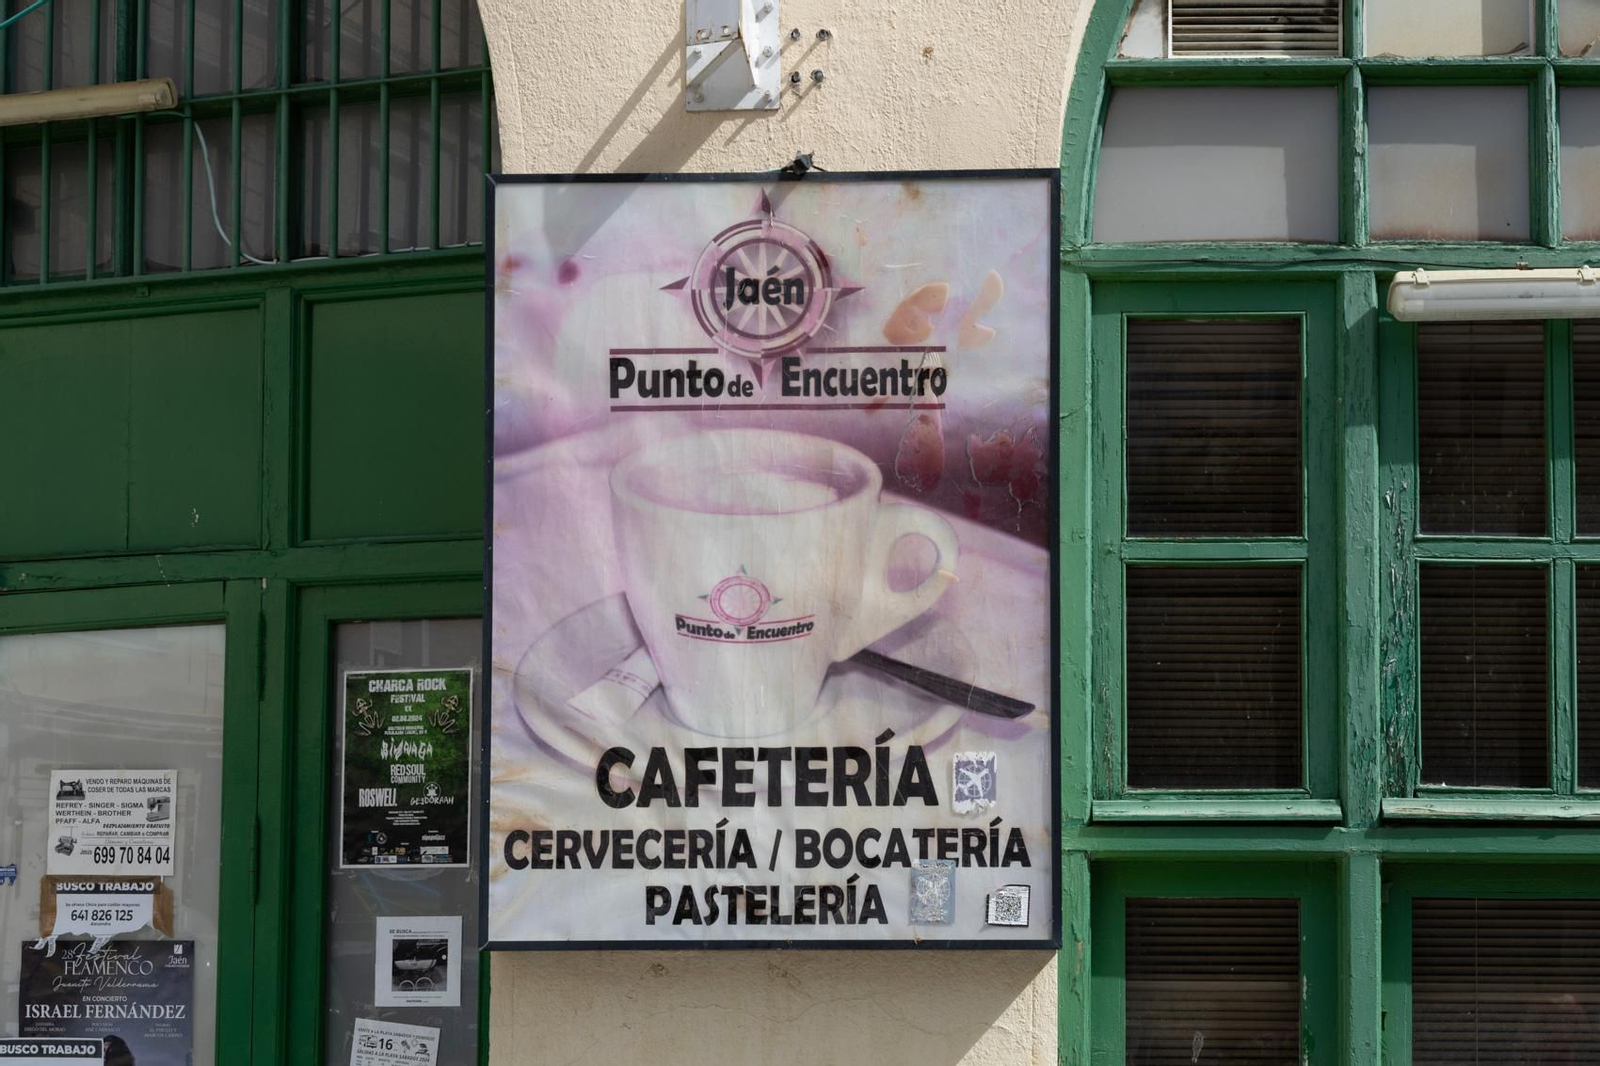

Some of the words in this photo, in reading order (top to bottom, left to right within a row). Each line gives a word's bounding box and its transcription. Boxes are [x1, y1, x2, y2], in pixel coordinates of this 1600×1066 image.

[723, 265, 804, 311] Jaén
[609, 356, 725, 399] Punto
[728, 374, 754, 397] de
[781, 356, 948, 398] Encuentro
[675, 616, 724, 639] Punto
[724, 630, 736, 640] de
[746, 621, 815, 641] Encuentro
[368, 679, 414, 693] CHARCA
[417, 677, 447, 692] ROCK
[390, 694, 426, 704] FESTIVAL
[390, 764, 405, 776] RED
[405, 764, 426, 776] SOUL
[596, 727, 939, 809] CAFETERÍA
[390, 775, 426, 784] COMMUNITY
[503, 817, 758, 870] CERVECERÍA
[769, 828, 783, 872] /
[795, 816, 1031, 870] BOCATERÍA
[93, 846, 116, 864] 699
[119, 846, 134, 864] 70
[137, 846, 152, 864] 84
[155, 846, 170, 864] 04
[56, 882, 95, 891] BUSCO
[98, 882, 154, 891] TRABAJO
[645, 872, 889, 926] PASTELERÍA
[71, 909, 88, 921] 641
[91, 909, 112, 921] 826
[115, 909, 133, 921] 125
[62, 950, 73, 959] 28
[72, 942, 142, 966] Festival
[168, 955, 187, 965] Jaén
[64, 960, 153, 976] FLAMENCO
[52, 976, 91, 993] Juanito
[94, 976, 159, 991] Valderrama
[25, 1004, 82, 1019] ISRAEL
[85, 1002, 186, 1019] FERNÁNDEZ
[0, 1044, 39, 1055] BUSCO
[41, 1044, 96, 1055] TRABAJO
[379, 1038, 394, 1051] 16
